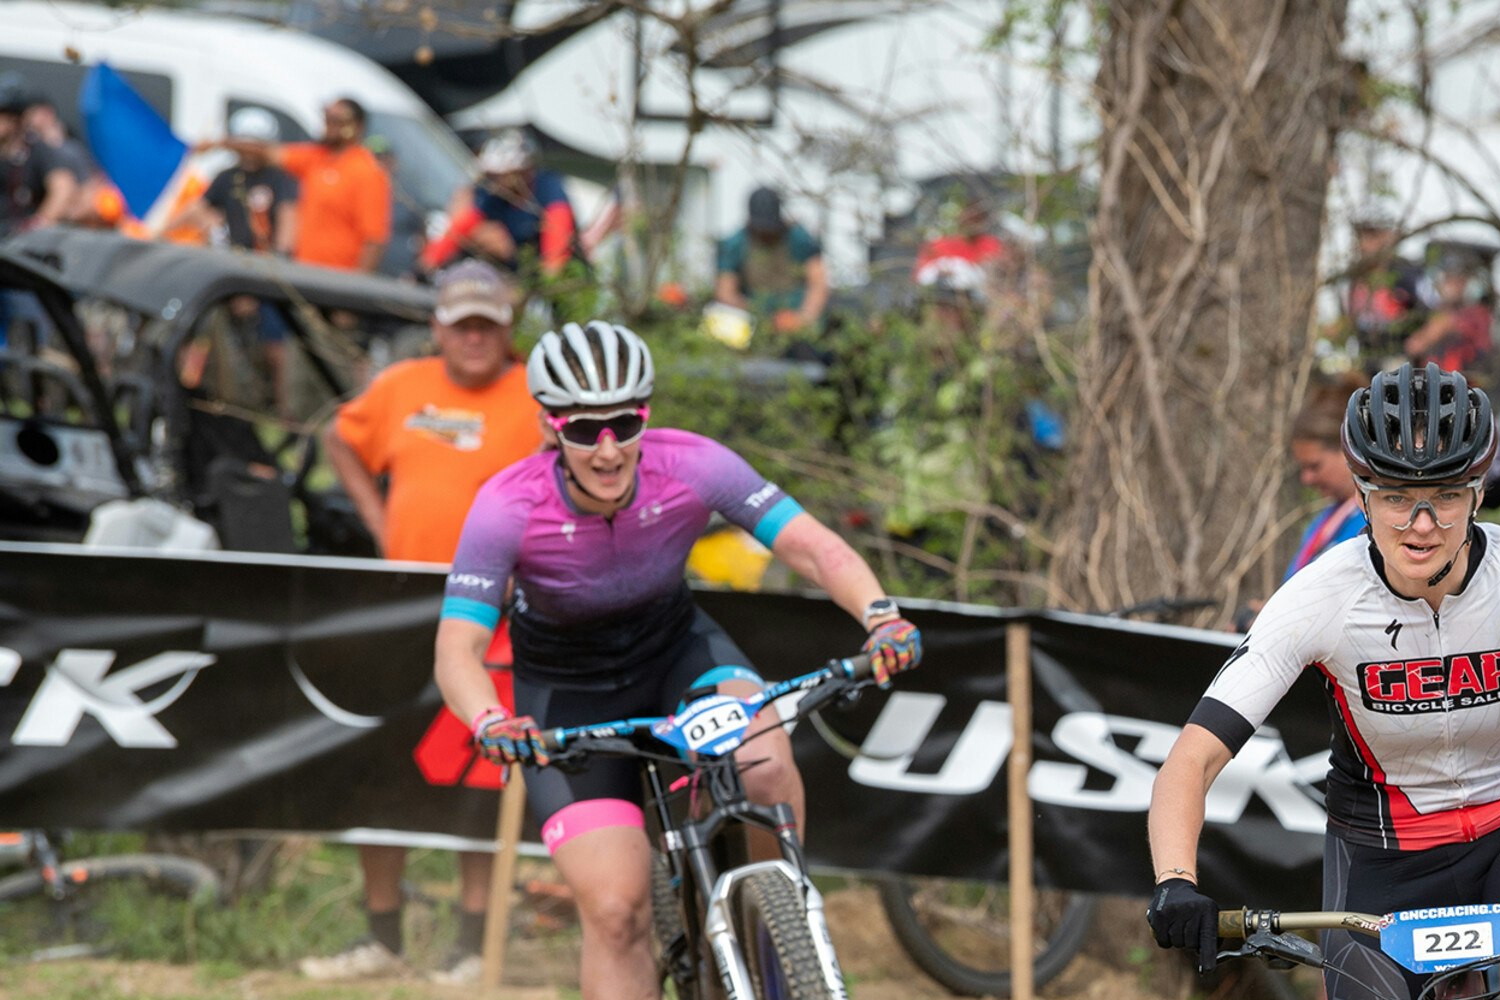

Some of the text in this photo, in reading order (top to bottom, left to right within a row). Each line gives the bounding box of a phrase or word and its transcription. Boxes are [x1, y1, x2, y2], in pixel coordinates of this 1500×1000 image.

[0, 646, 217, 749] K
[1371, 698, 1455, 713] BICYCLE
[689, 708, 744, 742] 014
[775, 682, 1327, 835] USK
[1424, 929, 1482, 954] 222
